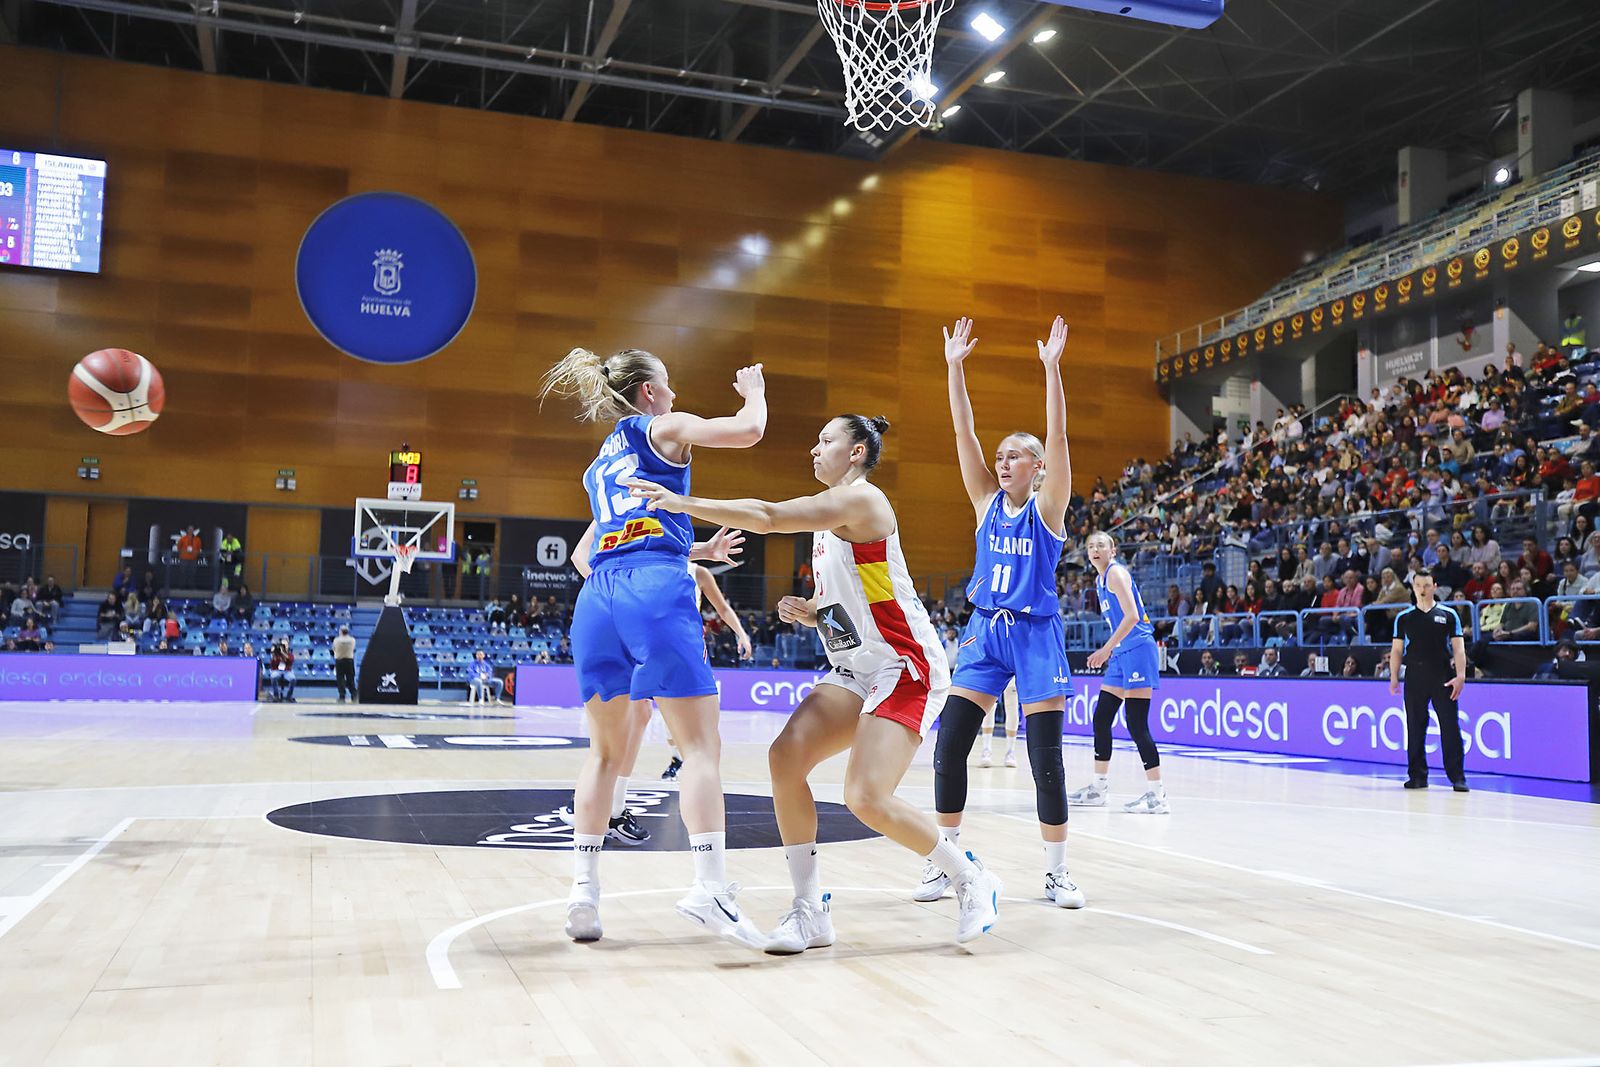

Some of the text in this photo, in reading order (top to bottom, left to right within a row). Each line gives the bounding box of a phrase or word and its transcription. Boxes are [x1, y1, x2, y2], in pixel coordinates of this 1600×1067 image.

[44, 160, 84, 170] ISLANDIA
[360, 303, 411, 317] HUELVA
[595, 453, 643, 520] 13
[602, 521, 651, 551] DHL
[521, 570, 578, 582] inetwok
[991, 563, 1012, 594] 11
[59, 668, 142, 688] endesa
[153, 671, 233, 688] endesa
[750, 675, 819, 705] end
[1160, 688, 1288, 741] endesa
